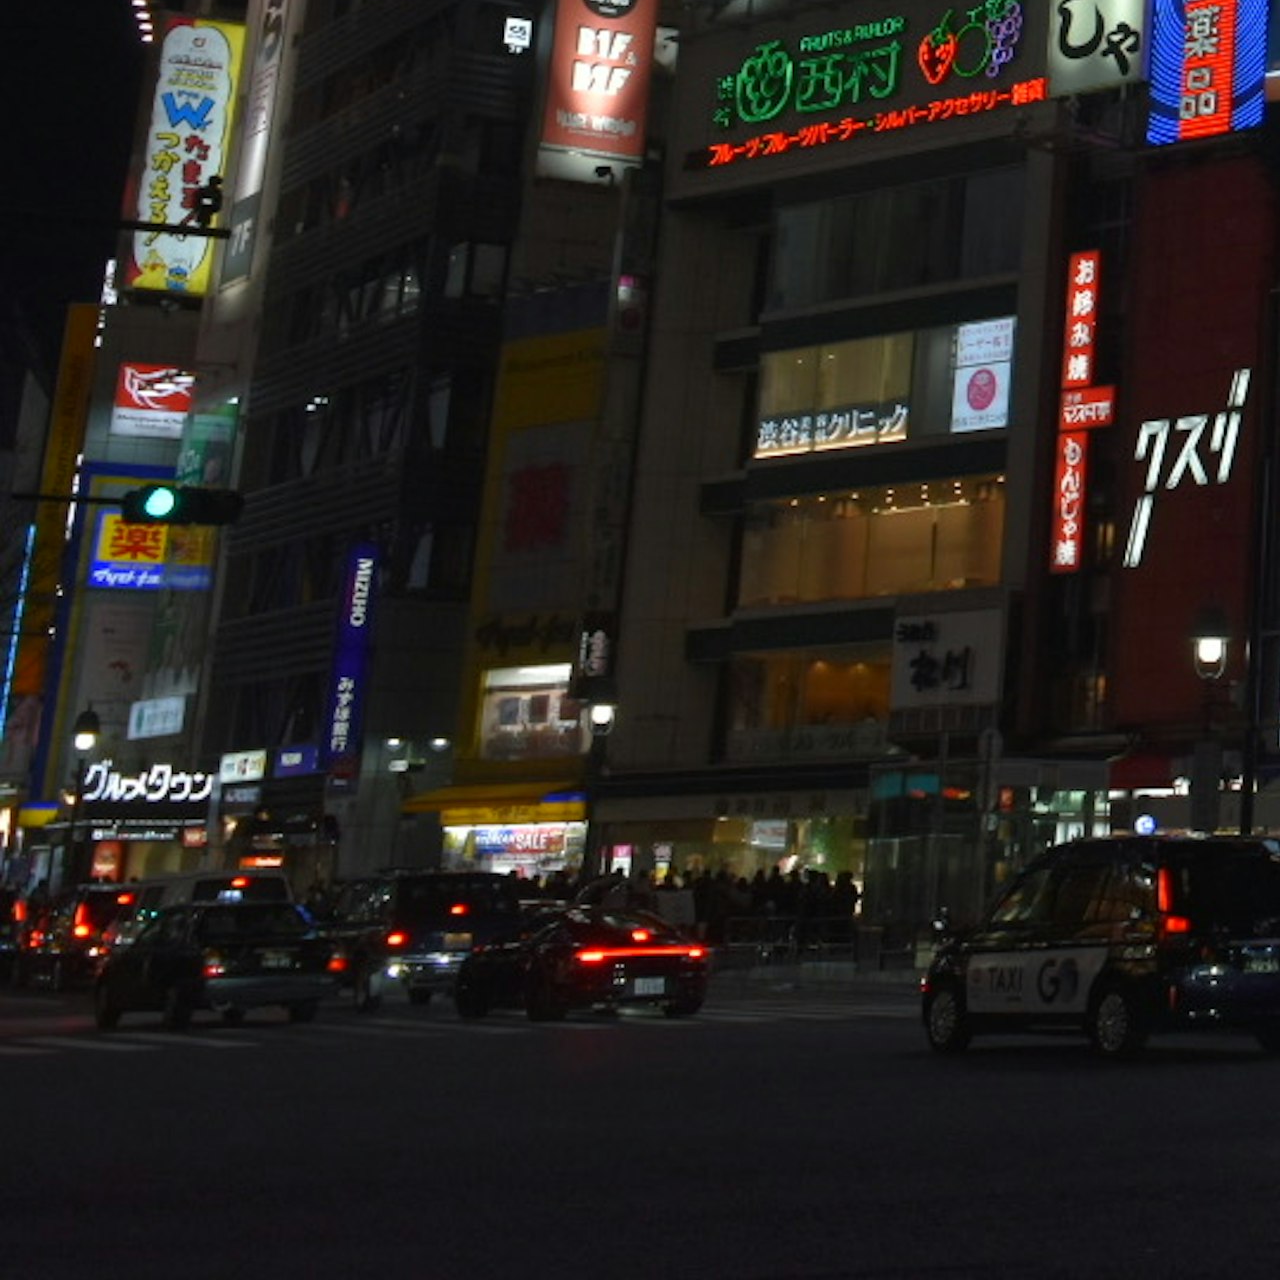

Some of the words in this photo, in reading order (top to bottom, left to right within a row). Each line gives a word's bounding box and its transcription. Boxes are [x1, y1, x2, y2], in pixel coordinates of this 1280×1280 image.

[795, 40, 902, 113] 西村
[1067, 258, 1095, 382] お好み焼
[1056, 438, 1082, 565] もんじゃ焼
[1122, 368, 1251, 568] クスリ
[111, 520, 161, 559] 薬
[350, 558, 373, 627] MIZUHO
[82, 759, 214, 801] グルメタウン
[988, 968, 1023, 991] TAXI
